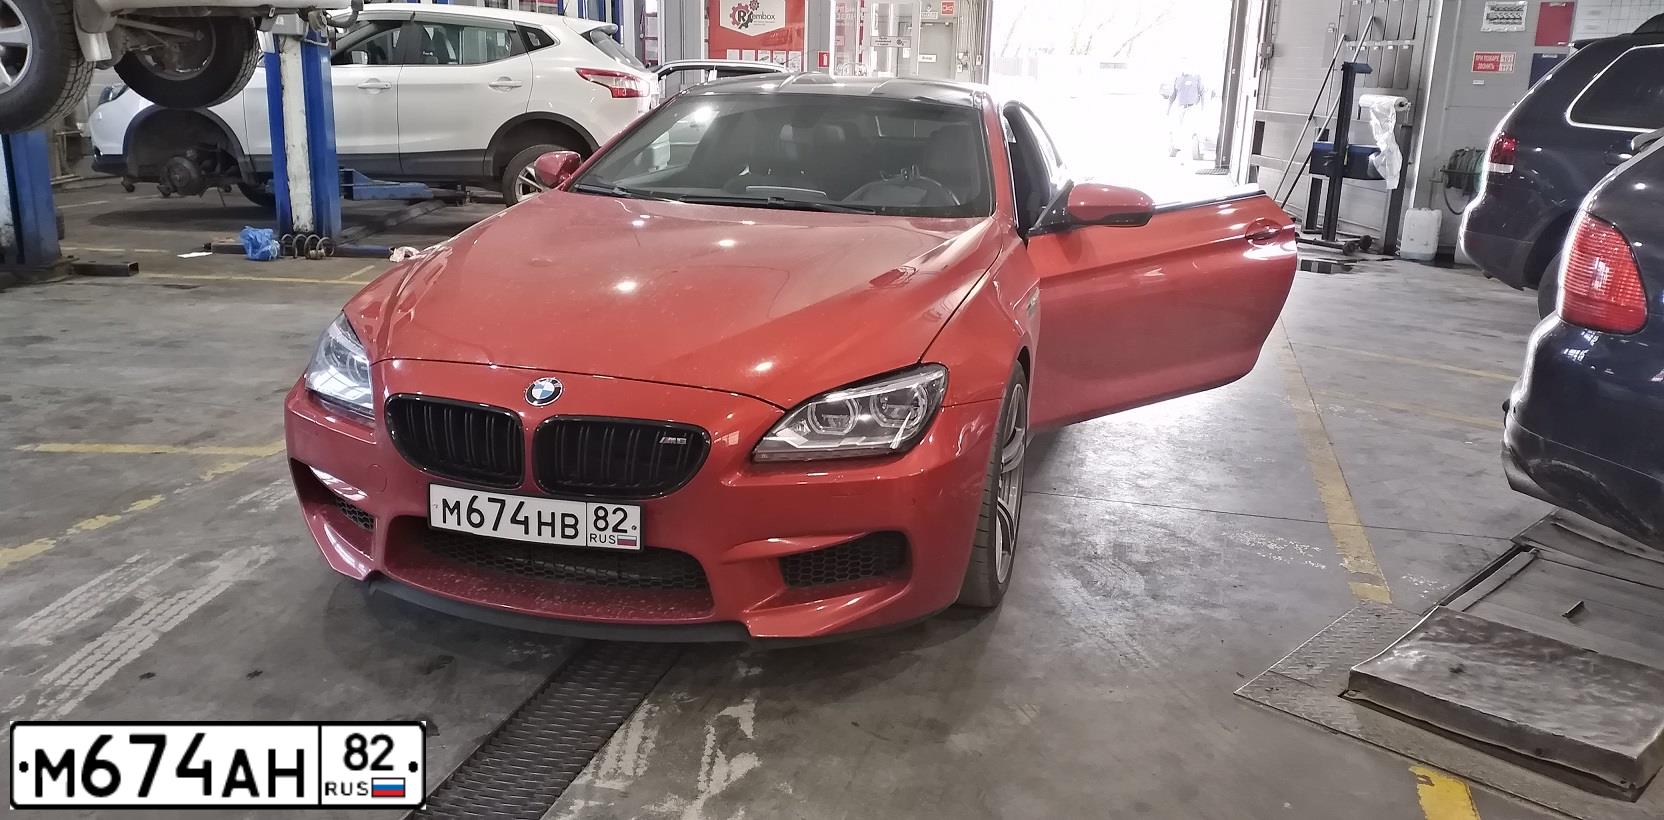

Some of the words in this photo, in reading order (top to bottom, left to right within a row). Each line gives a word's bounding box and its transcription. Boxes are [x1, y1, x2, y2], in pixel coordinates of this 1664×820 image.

[441, 495, 580, 540] М674НВ
[592, 506, 629, 534] 82
[589, 533, 616, 545] RUS
